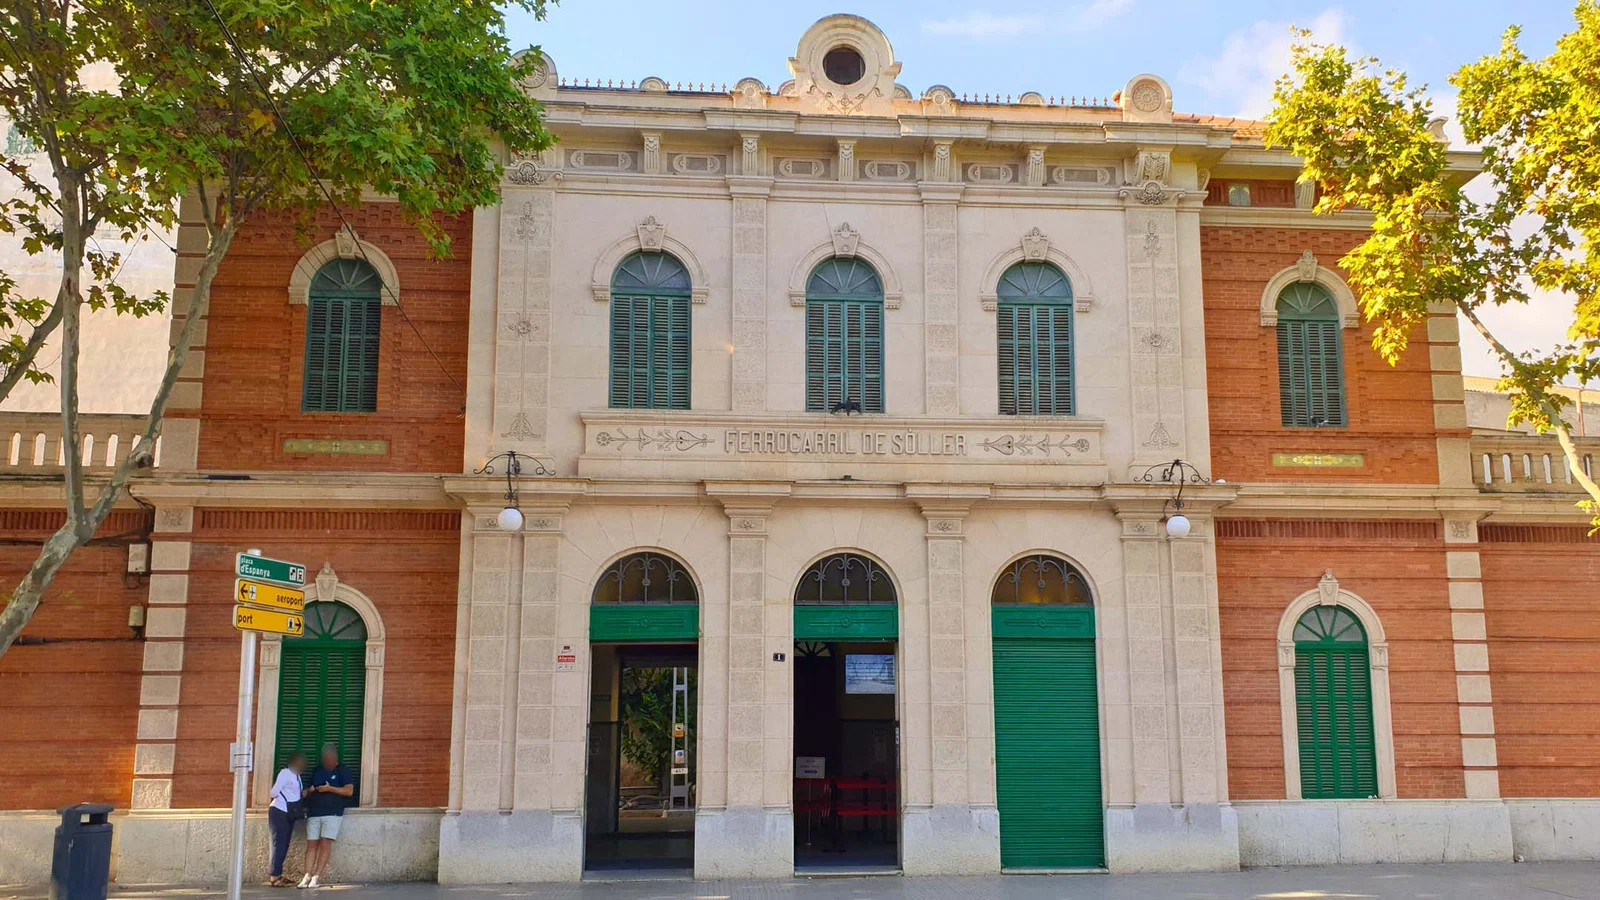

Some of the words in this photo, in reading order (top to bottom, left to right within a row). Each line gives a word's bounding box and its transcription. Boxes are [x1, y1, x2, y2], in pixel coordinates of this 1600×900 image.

[725, 430, 856, 454] FERROCARRIL
[862, 432, 886, 455] DE
[240, 564, 270, 577] d'Espanya
[276, 595, 303, 605] aeroport
[238, 614, 253, 625] port
